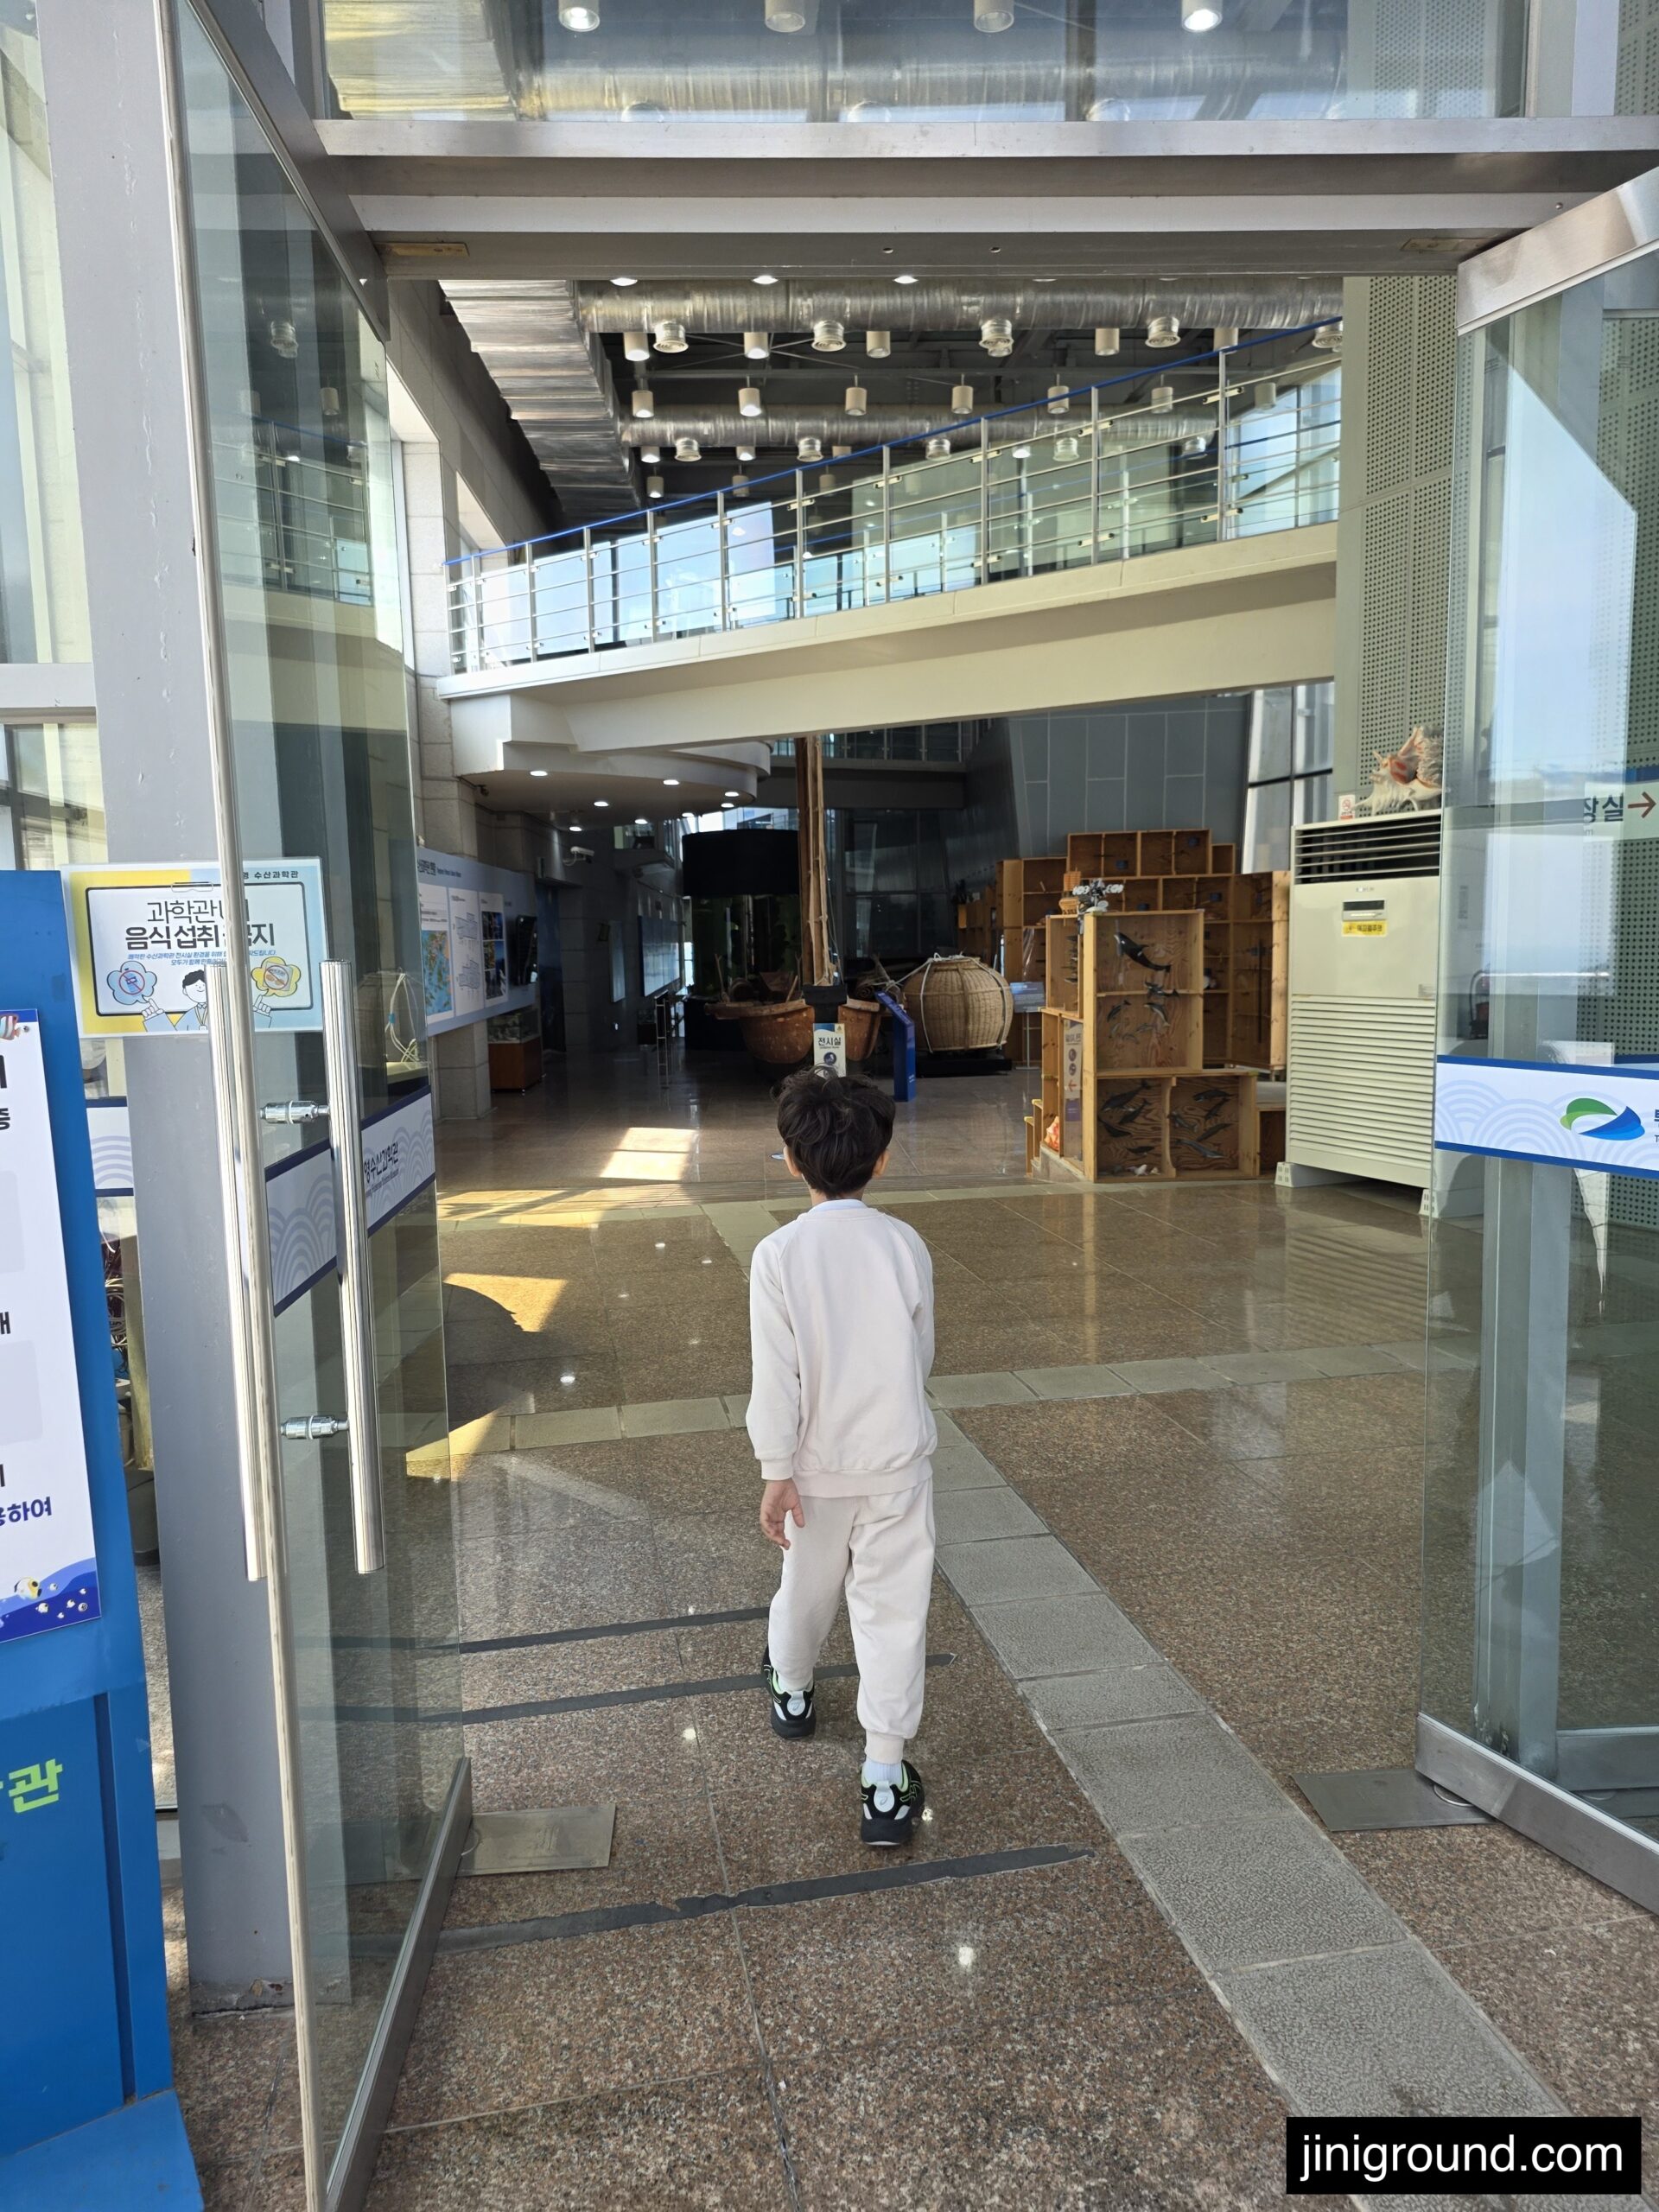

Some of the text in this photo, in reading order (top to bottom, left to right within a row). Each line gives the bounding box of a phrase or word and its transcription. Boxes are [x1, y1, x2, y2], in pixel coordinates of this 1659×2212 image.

[254, 870, 299, 880] 수산과학관
[147, 899, 218, 924] 과학관
[125, 925, 172, 950] 음식
[174, 925, 219, 949] 섭취
[817, 1037, 842, 1046] 전시실
